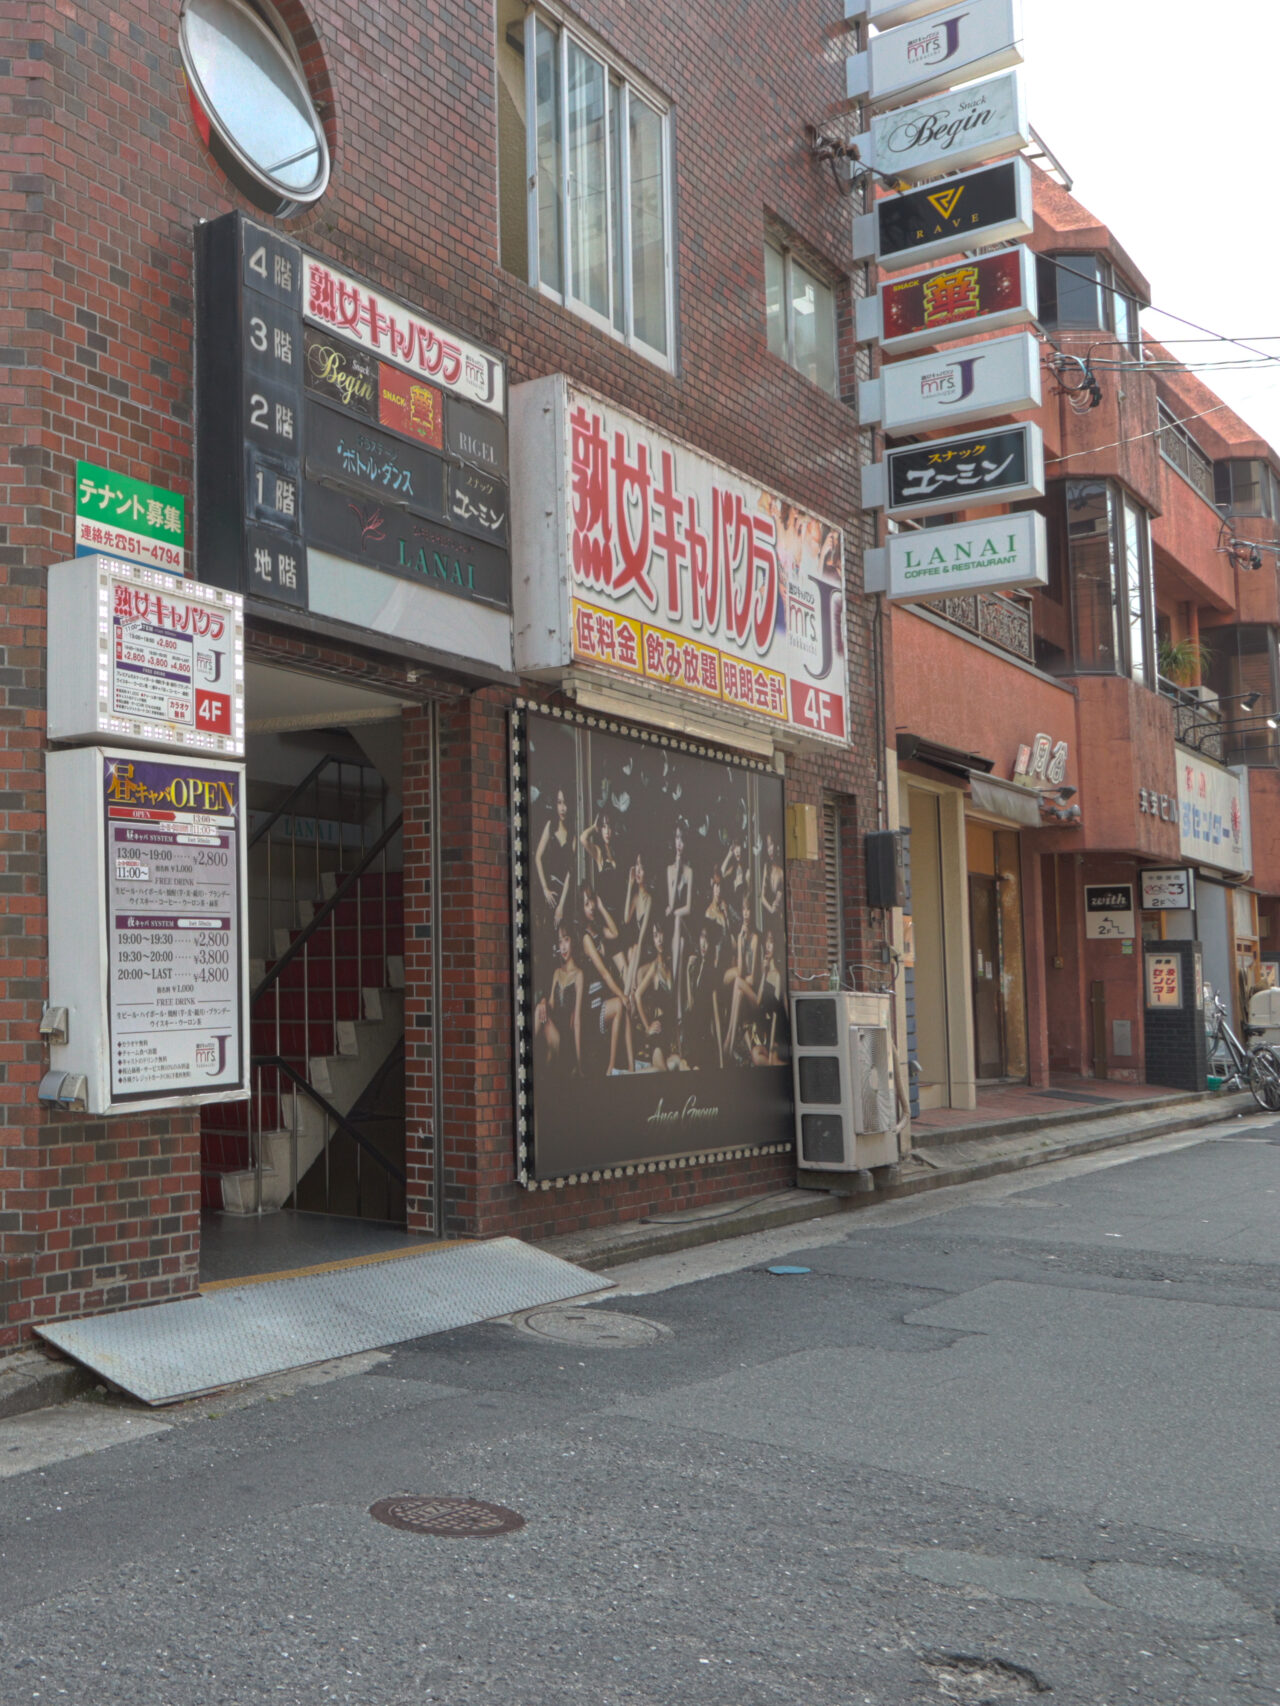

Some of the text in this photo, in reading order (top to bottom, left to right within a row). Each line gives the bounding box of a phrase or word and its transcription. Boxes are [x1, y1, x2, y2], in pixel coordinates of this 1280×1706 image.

[924, 12, 970, 66] J
[958, 95, 986, 112] Snack
[887, 107, 996, 152] Begin
[916, 213, 980, 240] RAVE
[249, 246, 292, 293] 4階
[893, 280, 919, 292] SNACK
[250, 316, 292, 365] 3階
[308, 264, 463, 384] 熟女キャバクラ
[307, 344, 375, 404] Begin
[475, 354, 499, 403] J
[938, 355, 986, 404] J
[250, 393, 293, 440] 2階
[382, 389, 406, 407] SNACK
[459, 431, 498, 465] RIGEL
[928, 444, 987, 465] スナック
[256, 471, 294, 516] 1階
[902, 453, 1015, 496] ユーミン
[79, 478, 182, 534] テナント募集
[81, 523, 115, 548] 連絡先
[570, 404, 778, 652] 熟女キャバクラ
[254, 548, 297, 590] 地階
[398, 538, 476, 590] LANAI
[904, 534, 1017, 569] LANAI
[904, 555, 1017, 579] COFFEE & RESTAURANT
[113, 584, 225, 641] 熟女キャバクラ
[804, 574, 843, 681] J
[575, 607, 638, 667] 低料金
[204, 648, 226, 683] J
[645, 632, 718, 691] 飲み放題
[723, 661, 784, 715] 明朗会計
[804, 688, 832, 730] 4F
[198, 698, 223, 722] 4F
[150, 835, 174, 843] SYSTEM
[193, 851, 228, 867] ¥2,800
[155, 877, 194, 886] FREE DRINK
[194, 932, 229, 947] ¥2,800
[194, 950, 229, 964] ¥3,800
[193, 967, 229, 983] ¥4,800
[175, 998, 196, 1006] DRINK
[205, 1034, 233, 1077] J
